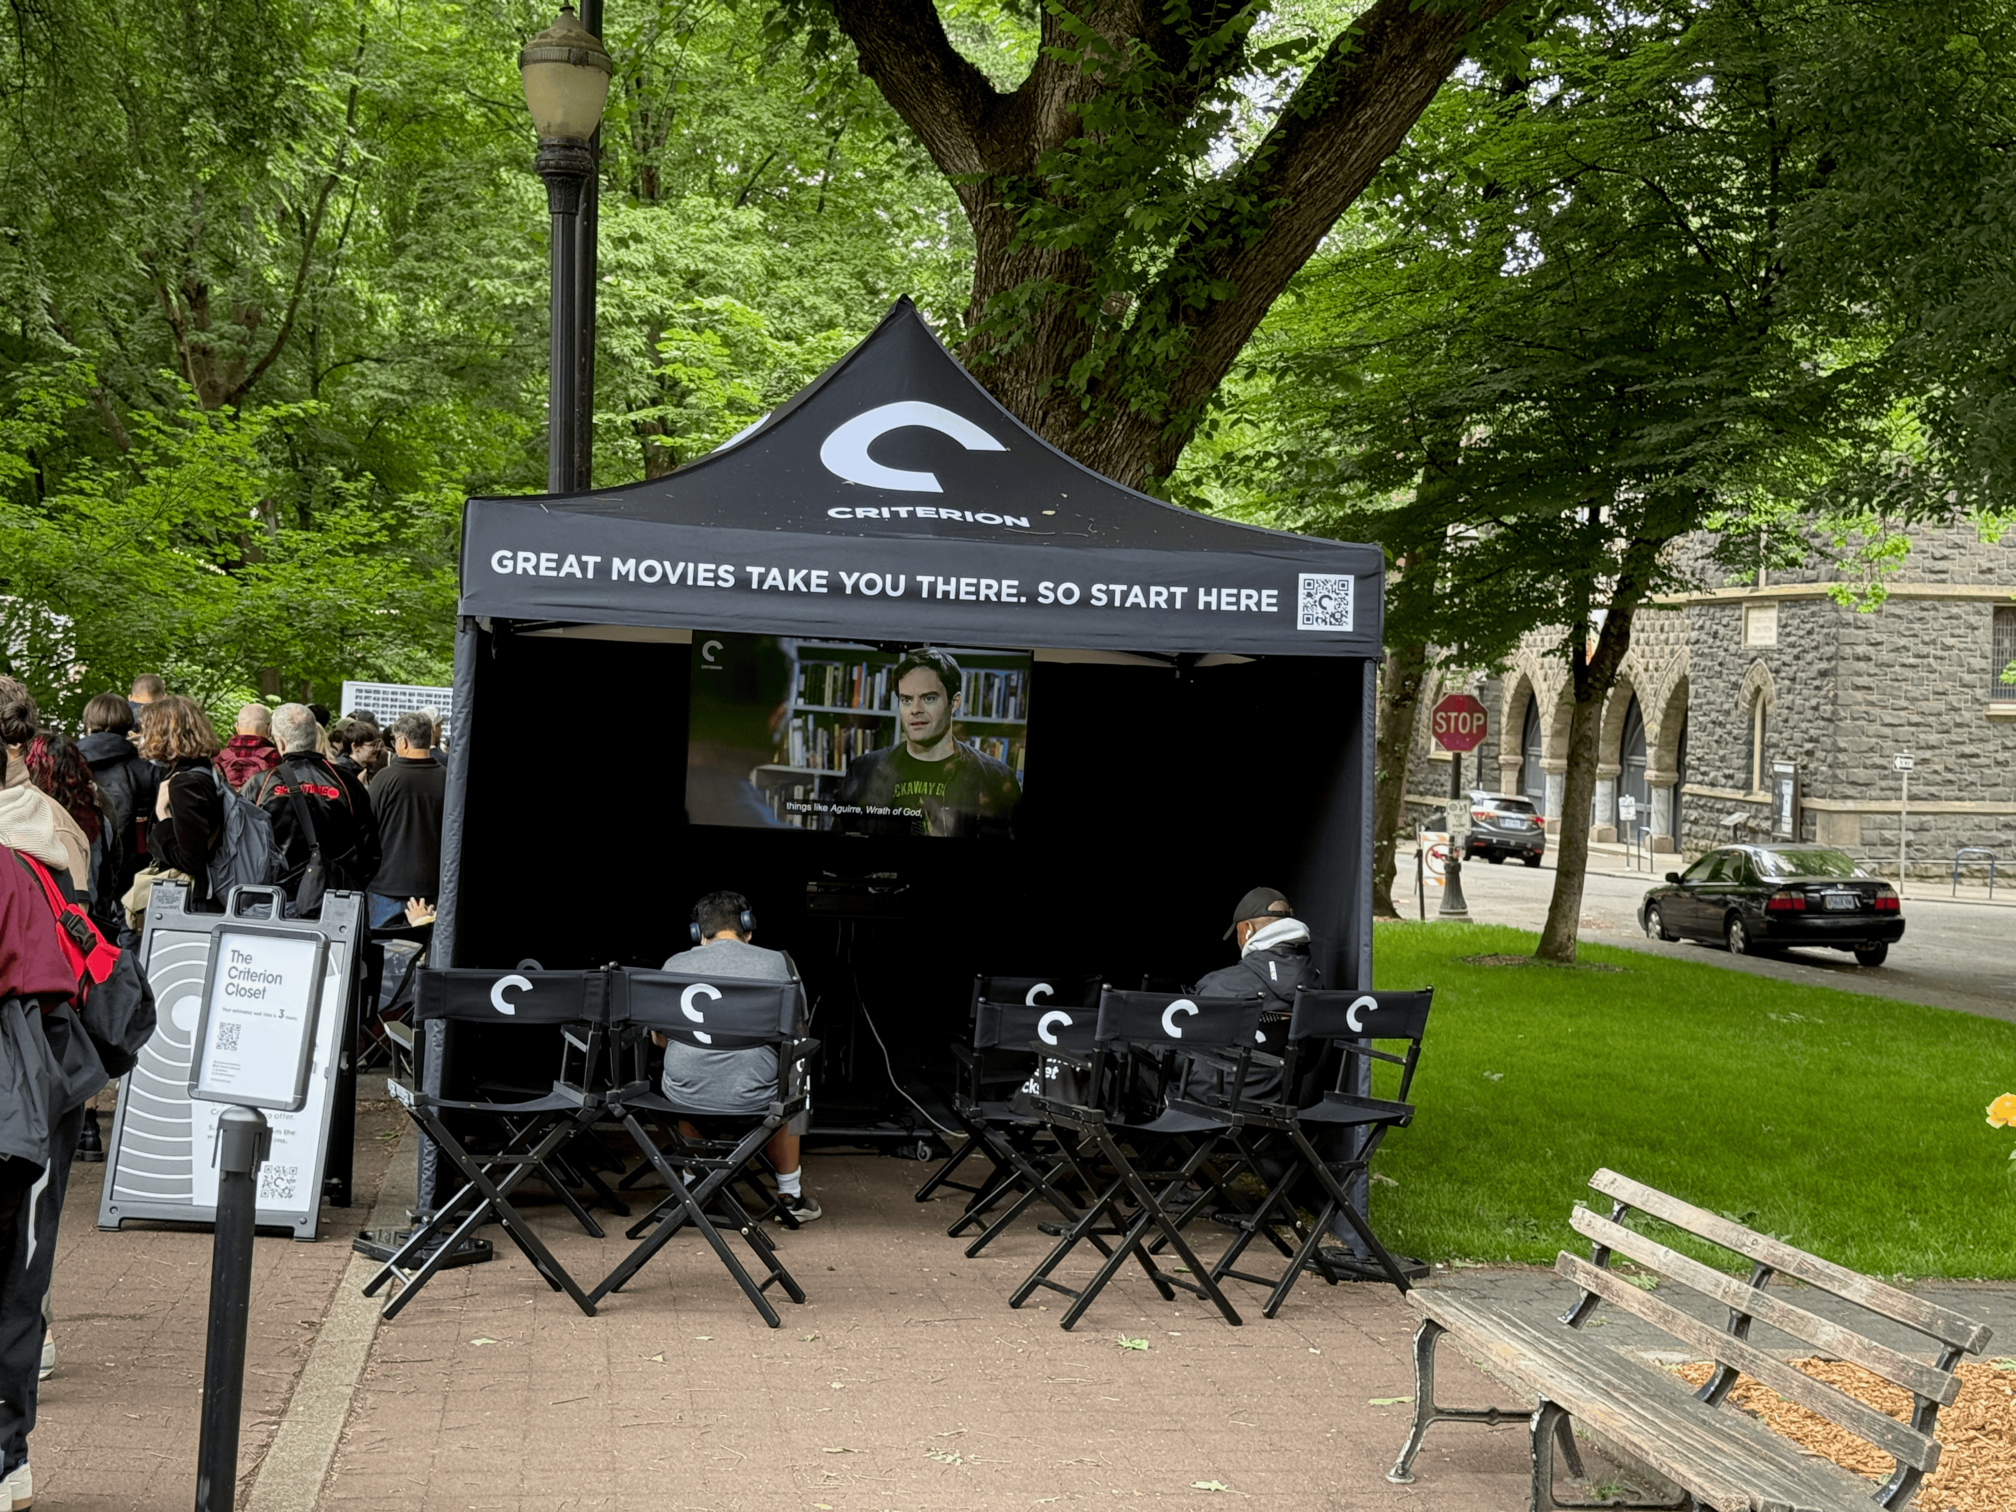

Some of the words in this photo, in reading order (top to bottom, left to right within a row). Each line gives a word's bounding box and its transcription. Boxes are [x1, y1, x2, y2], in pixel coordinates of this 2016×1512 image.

[827, 507, 1030, 527] CRITERION
[491, 550, 601, 579] GREAT
[612, 557, 735, 587] MOVIES
[746, 566, 828, 593] TAKE
[839, 571, 905, 596] YOU
[916, 575, 1026, 602] THERE.
[1038, 581, 1080, 605] SO
[1090, 584, 1188, 609] START
[1198, 588, 1278, 612] HERE
[1434, 711, 1486, 735] STOP
[893, 780, 936, 798] CKAWAY
[786, 802, 812, 813] things
[813, 803, 829, 812] like
[830, 804, 863, 816] Aguirre,
[866, 805, 891, 816] Wrath
[892, 807, 902, 816] of
[903, 808, 923, 818] God,
[231, 949, 253, 965] The
[228, 966, 283, 985] Criterion
[225, 982, 266, 1000] Closet
[278, 1008, 285, 1019] 3
